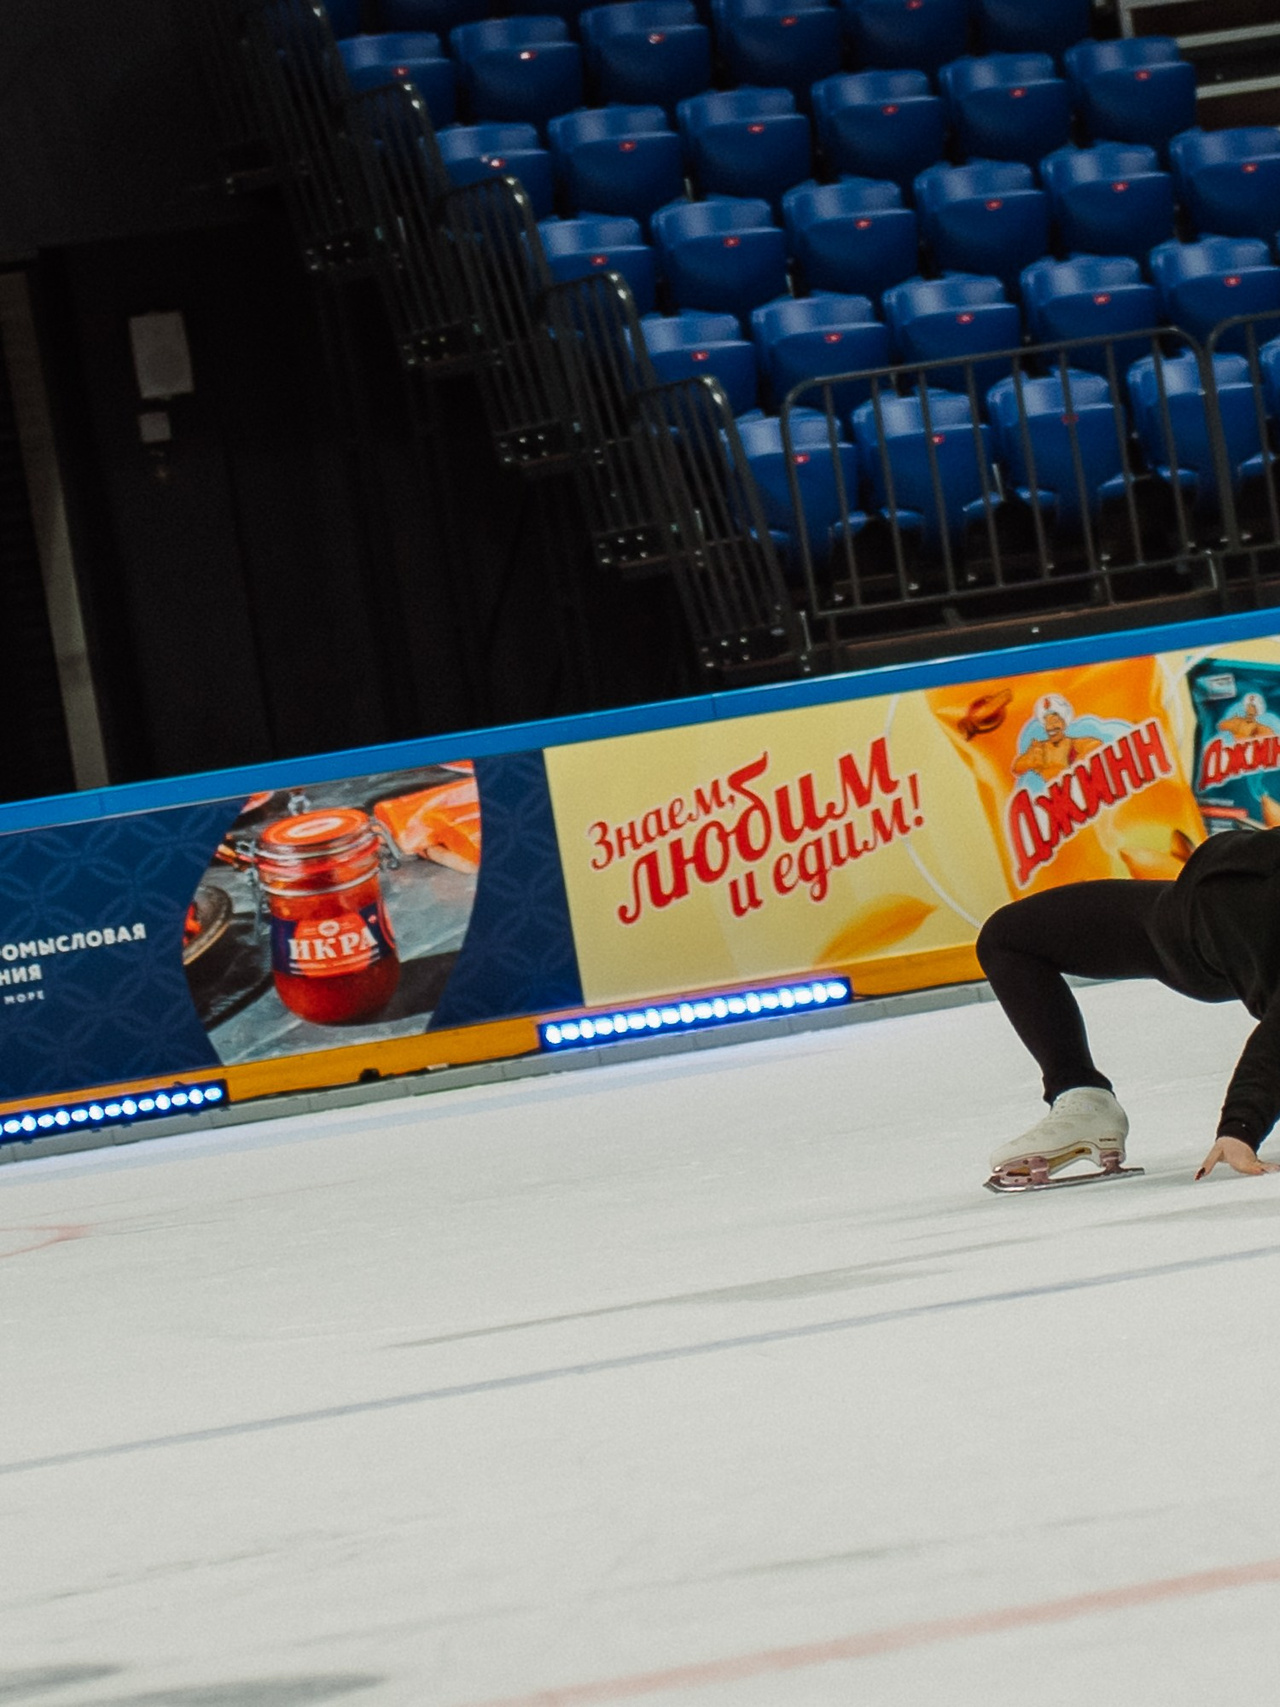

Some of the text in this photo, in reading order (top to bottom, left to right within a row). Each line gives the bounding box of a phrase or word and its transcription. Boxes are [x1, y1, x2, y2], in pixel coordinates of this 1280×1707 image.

[590, 779, 736, 871] Знаем,
[617, 735, 900, 926] любим
[728, 773, 926, 918] и едим!
[1009, 721, 1173, 886] ДЖИНН
[0, 922, 147, 962] ОМЫСЛОВАЯ
